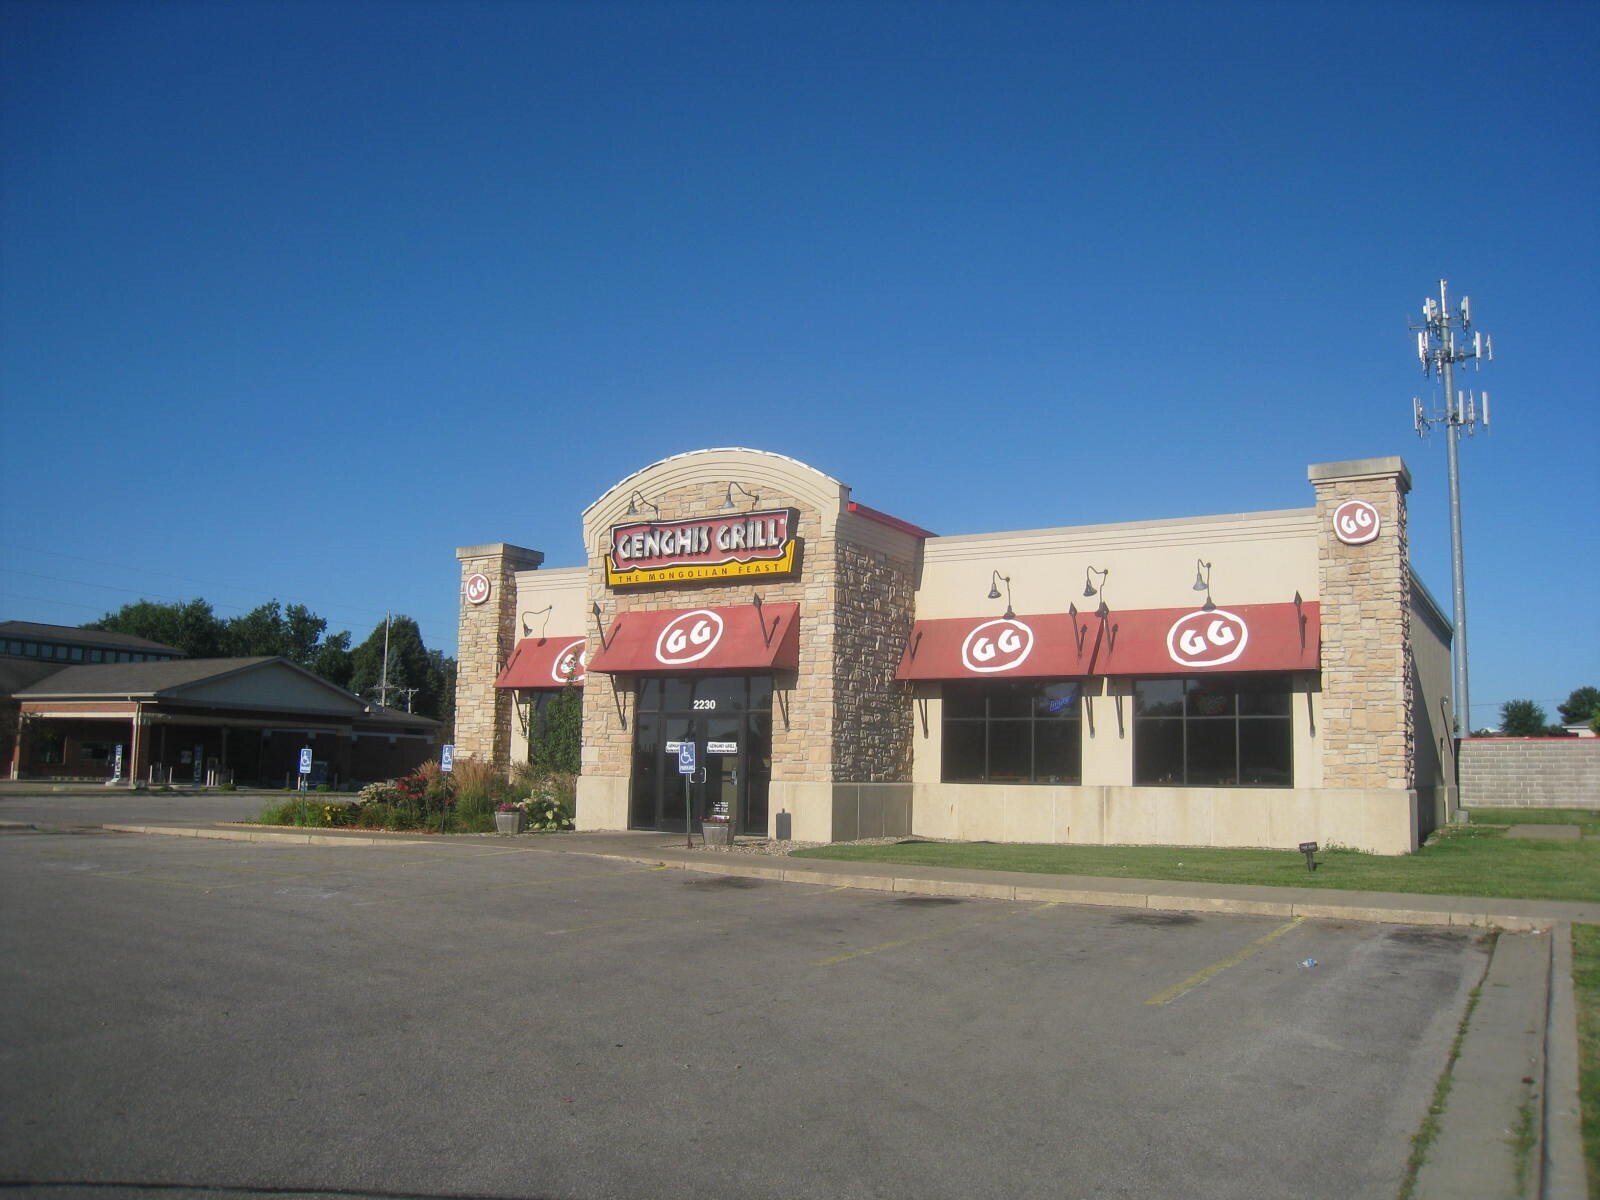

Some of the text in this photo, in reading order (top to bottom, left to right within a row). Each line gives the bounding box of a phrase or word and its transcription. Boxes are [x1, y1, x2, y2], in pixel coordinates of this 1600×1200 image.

[617, 519, 779, 560] GENGHIS GRILL
[618, 563, 779, 583] THE MONGOLIAN FEAST
[666, 620, 711, 653] GG
[972, 629, 1020, 662] GG
[1180, 620, 1234, 655] GG
[693, 700, 716, 710] 2230
